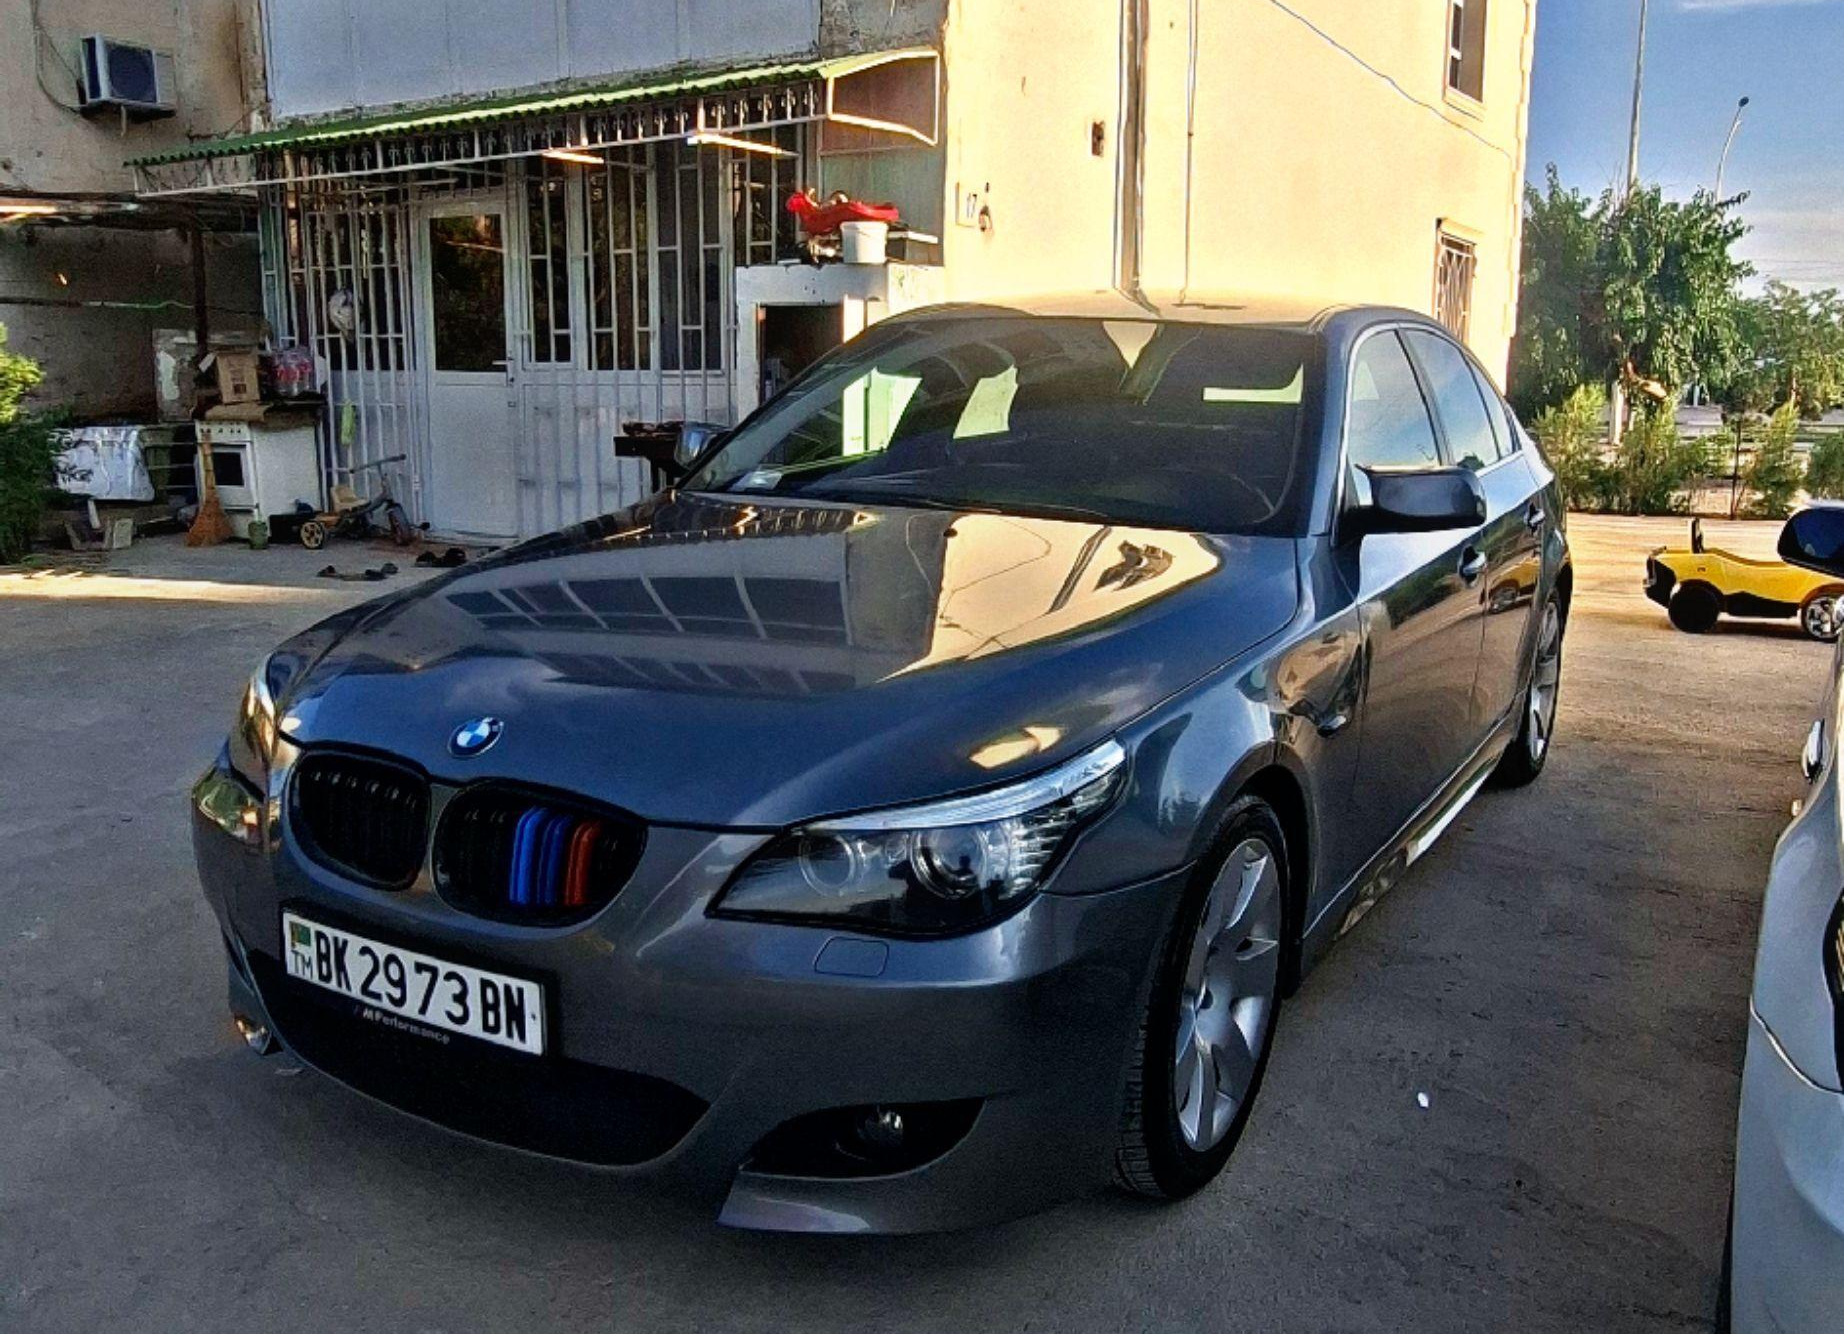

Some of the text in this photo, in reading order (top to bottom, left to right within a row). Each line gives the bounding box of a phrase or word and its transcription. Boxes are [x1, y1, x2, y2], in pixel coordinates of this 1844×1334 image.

[290, 949, 314, 981] TM
[315, 929, 527, 1045] BK 2973 BN
